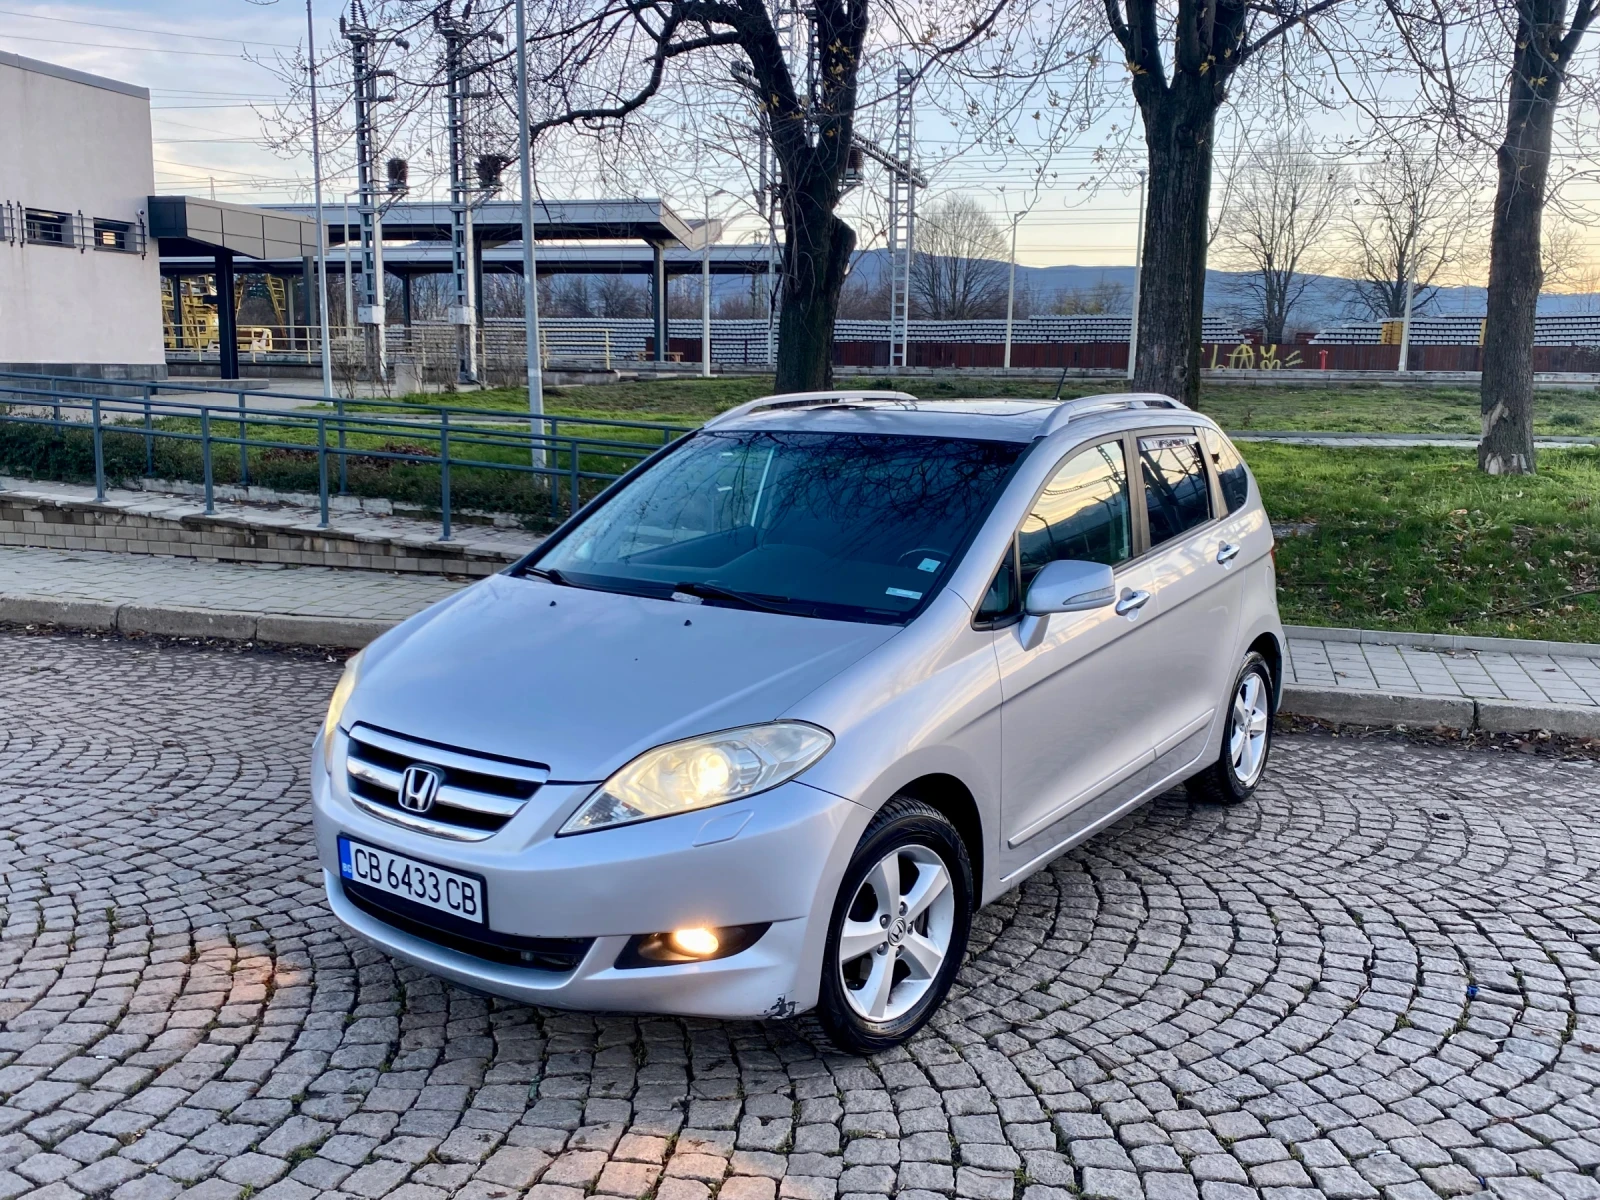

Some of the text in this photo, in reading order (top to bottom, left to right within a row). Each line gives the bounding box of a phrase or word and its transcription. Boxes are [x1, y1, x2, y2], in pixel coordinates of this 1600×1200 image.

[342, 862, 352, 874] BG
[355, 848, 477, 915] CB 6433 CB
